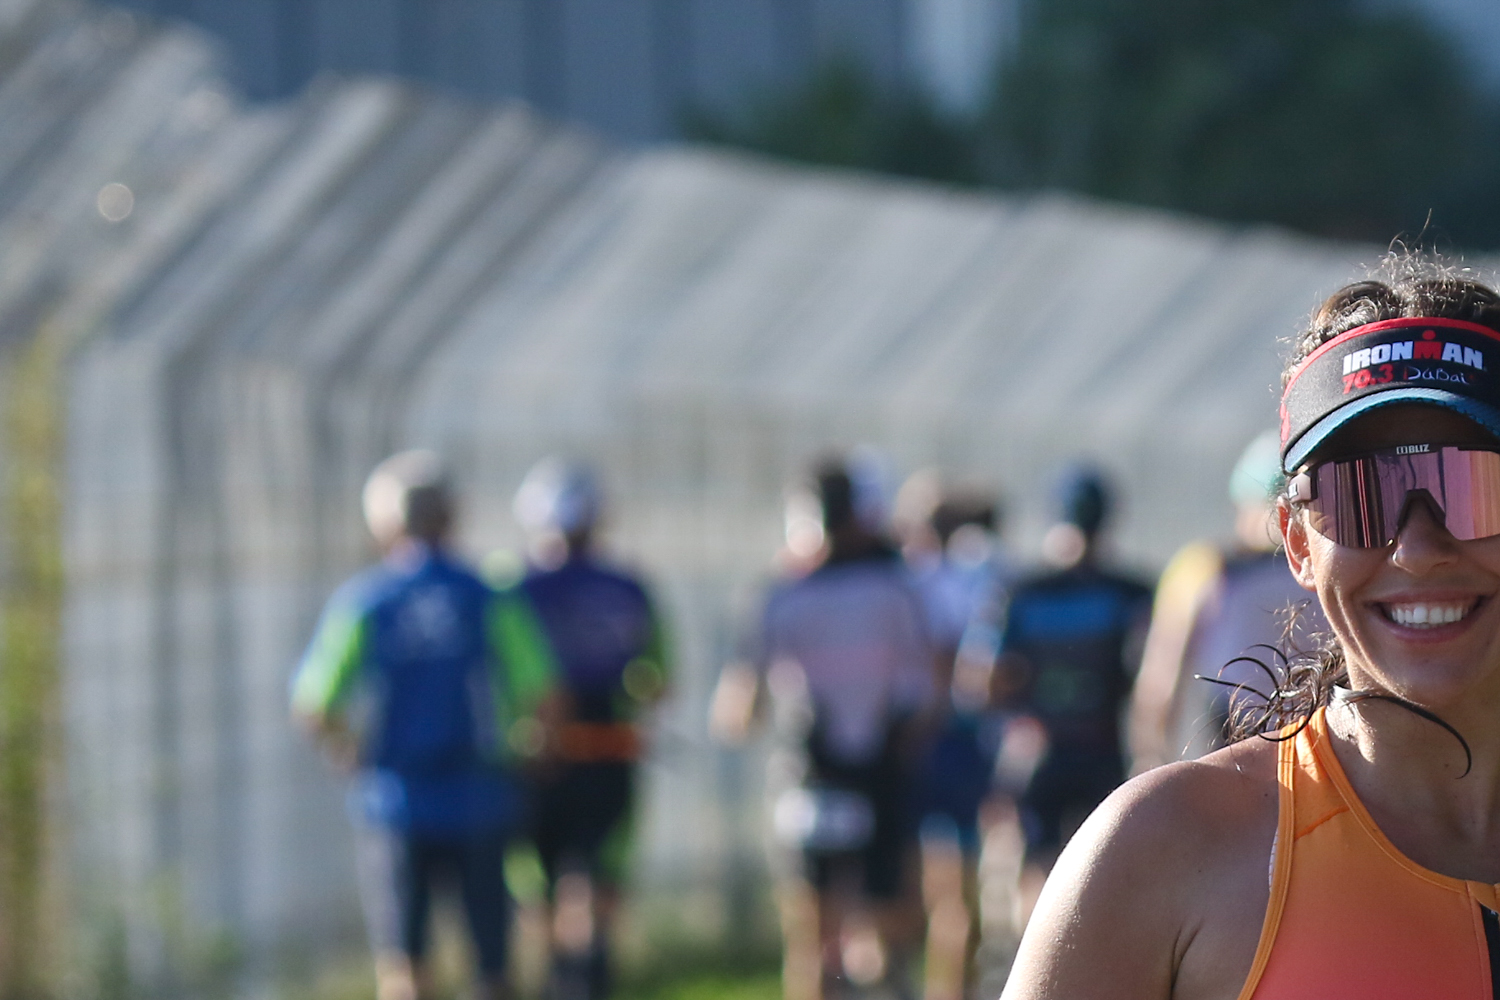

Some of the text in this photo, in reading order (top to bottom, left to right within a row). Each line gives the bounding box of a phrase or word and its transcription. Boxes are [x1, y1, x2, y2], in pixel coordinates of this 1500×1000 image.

[1342, 330, 1483, 376] IRONMAN
[1342, 364, 1393, 394] 70.3
[1408, 443, 1430, 454] BLIZ
